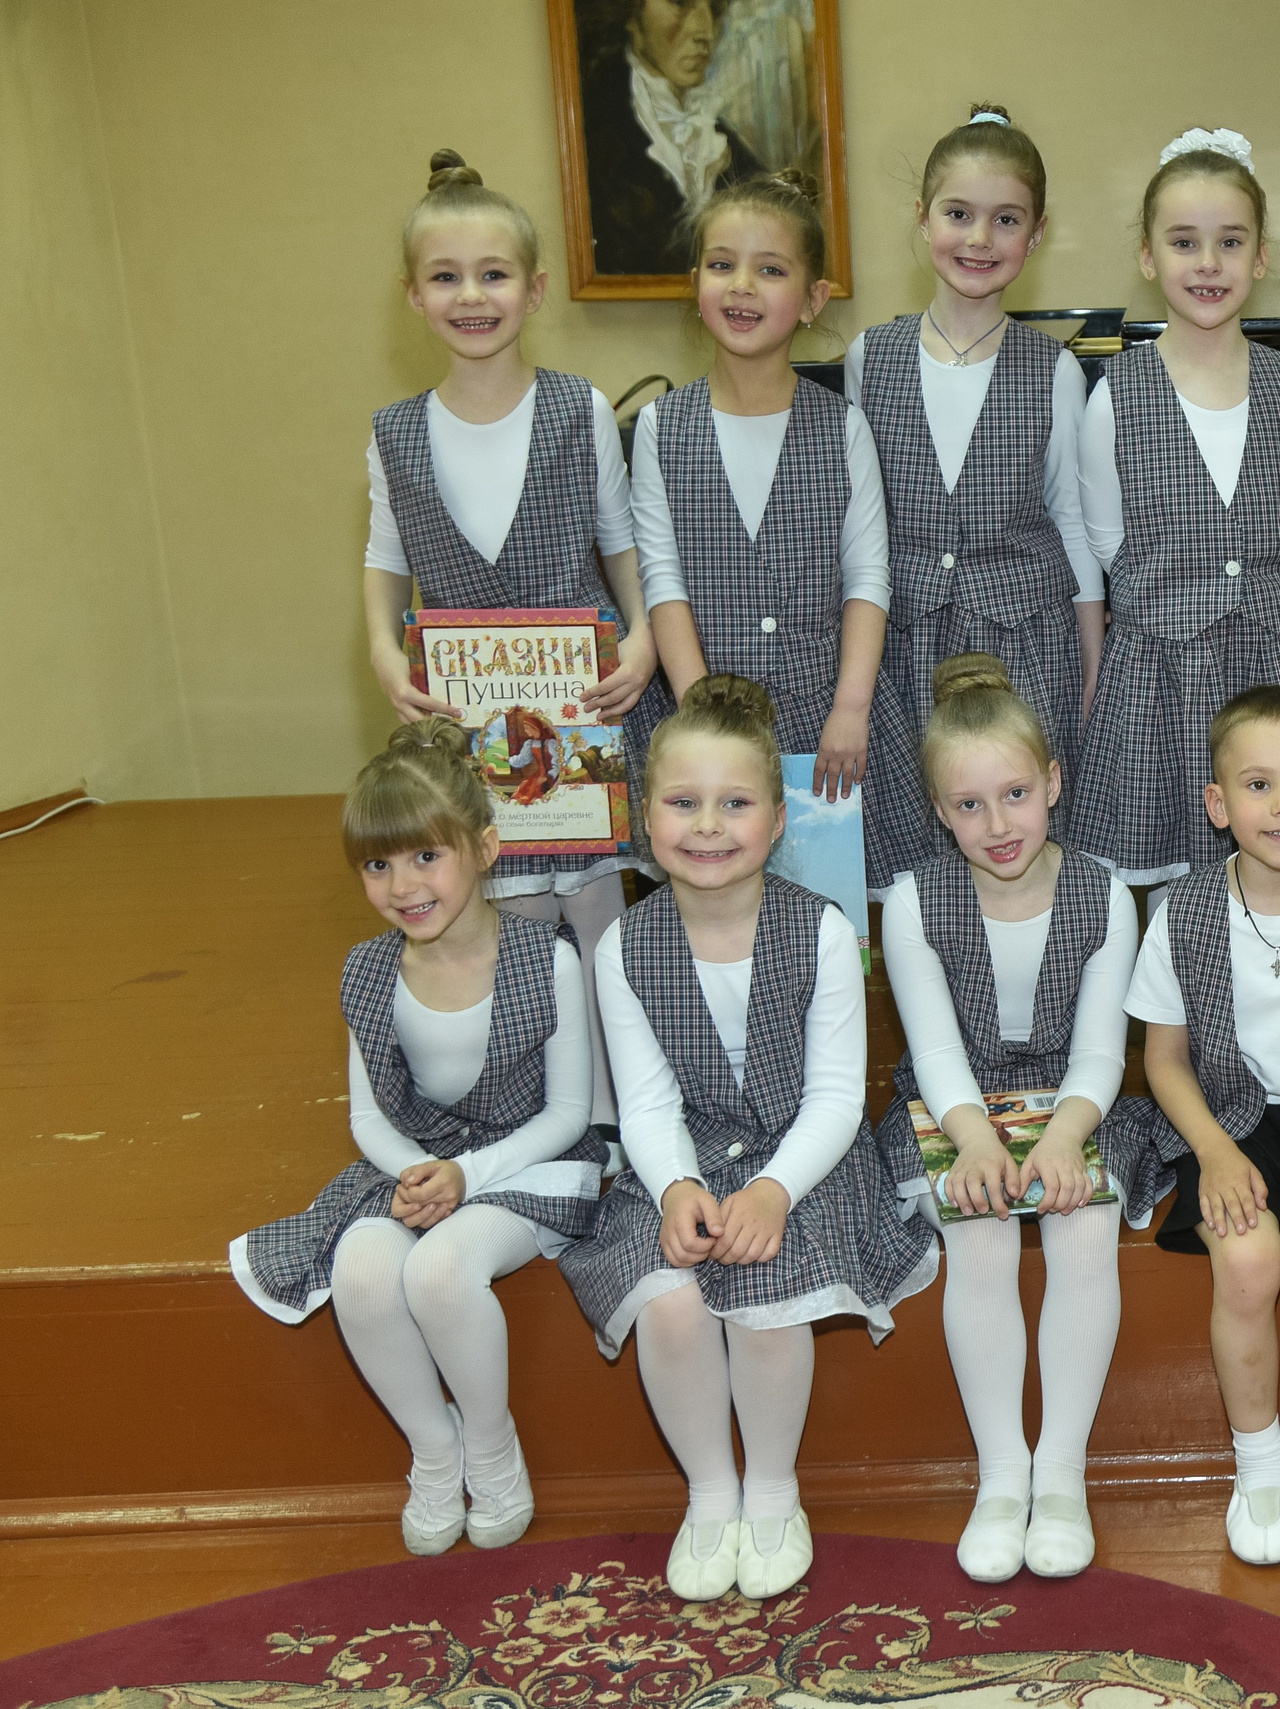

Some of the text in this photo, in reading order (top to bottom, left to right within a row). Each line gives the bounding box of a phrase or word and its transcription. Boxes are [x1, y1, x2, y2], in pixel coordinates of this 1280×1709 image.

[430, 636, 594, 678] СКАЗКИ
[445, 679, 587, 706] Пушкина
[553, 811, 594, 821] царевне
